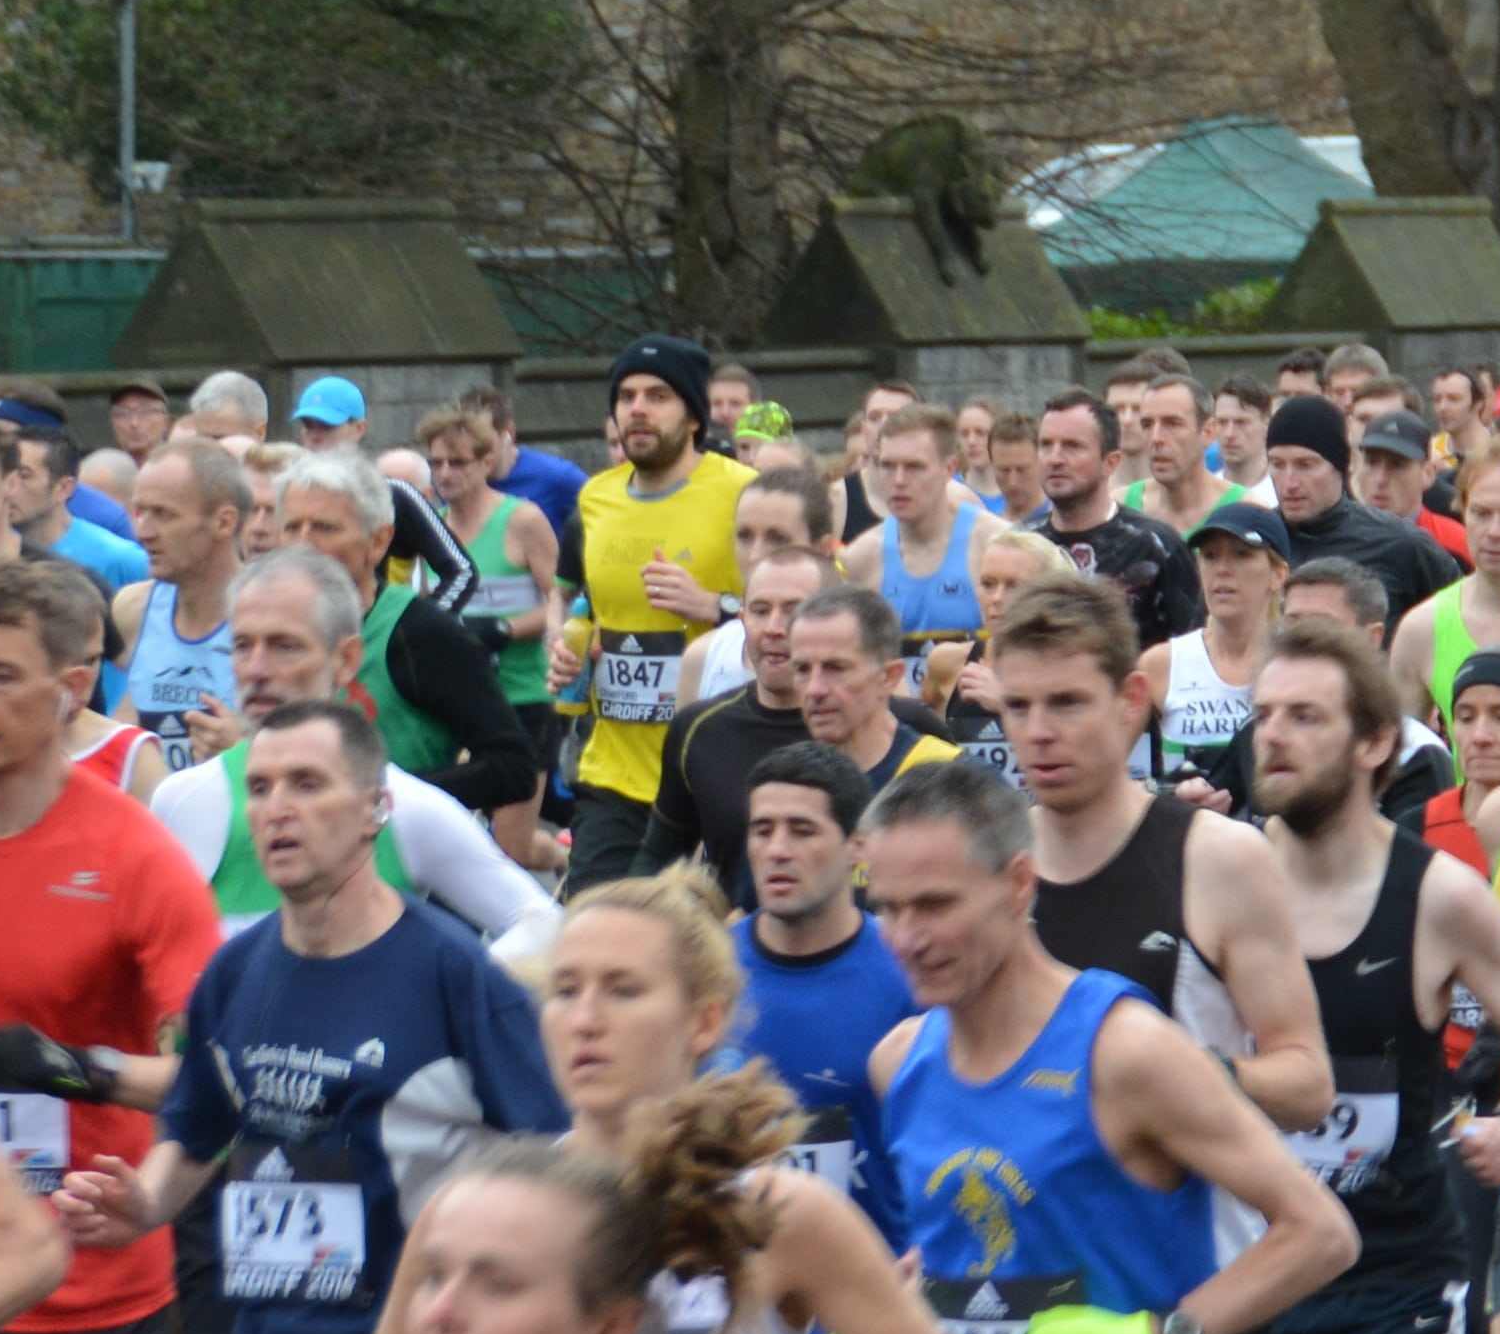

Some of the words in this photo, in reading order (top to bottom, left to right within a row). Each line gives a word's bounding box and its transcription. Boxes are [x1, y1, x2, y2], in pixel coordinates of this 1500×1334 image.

[606, 658, 666, 688] 1847
[601, 701, 654, 723] CARDIFF
[656, 705, 675, 723] 20
